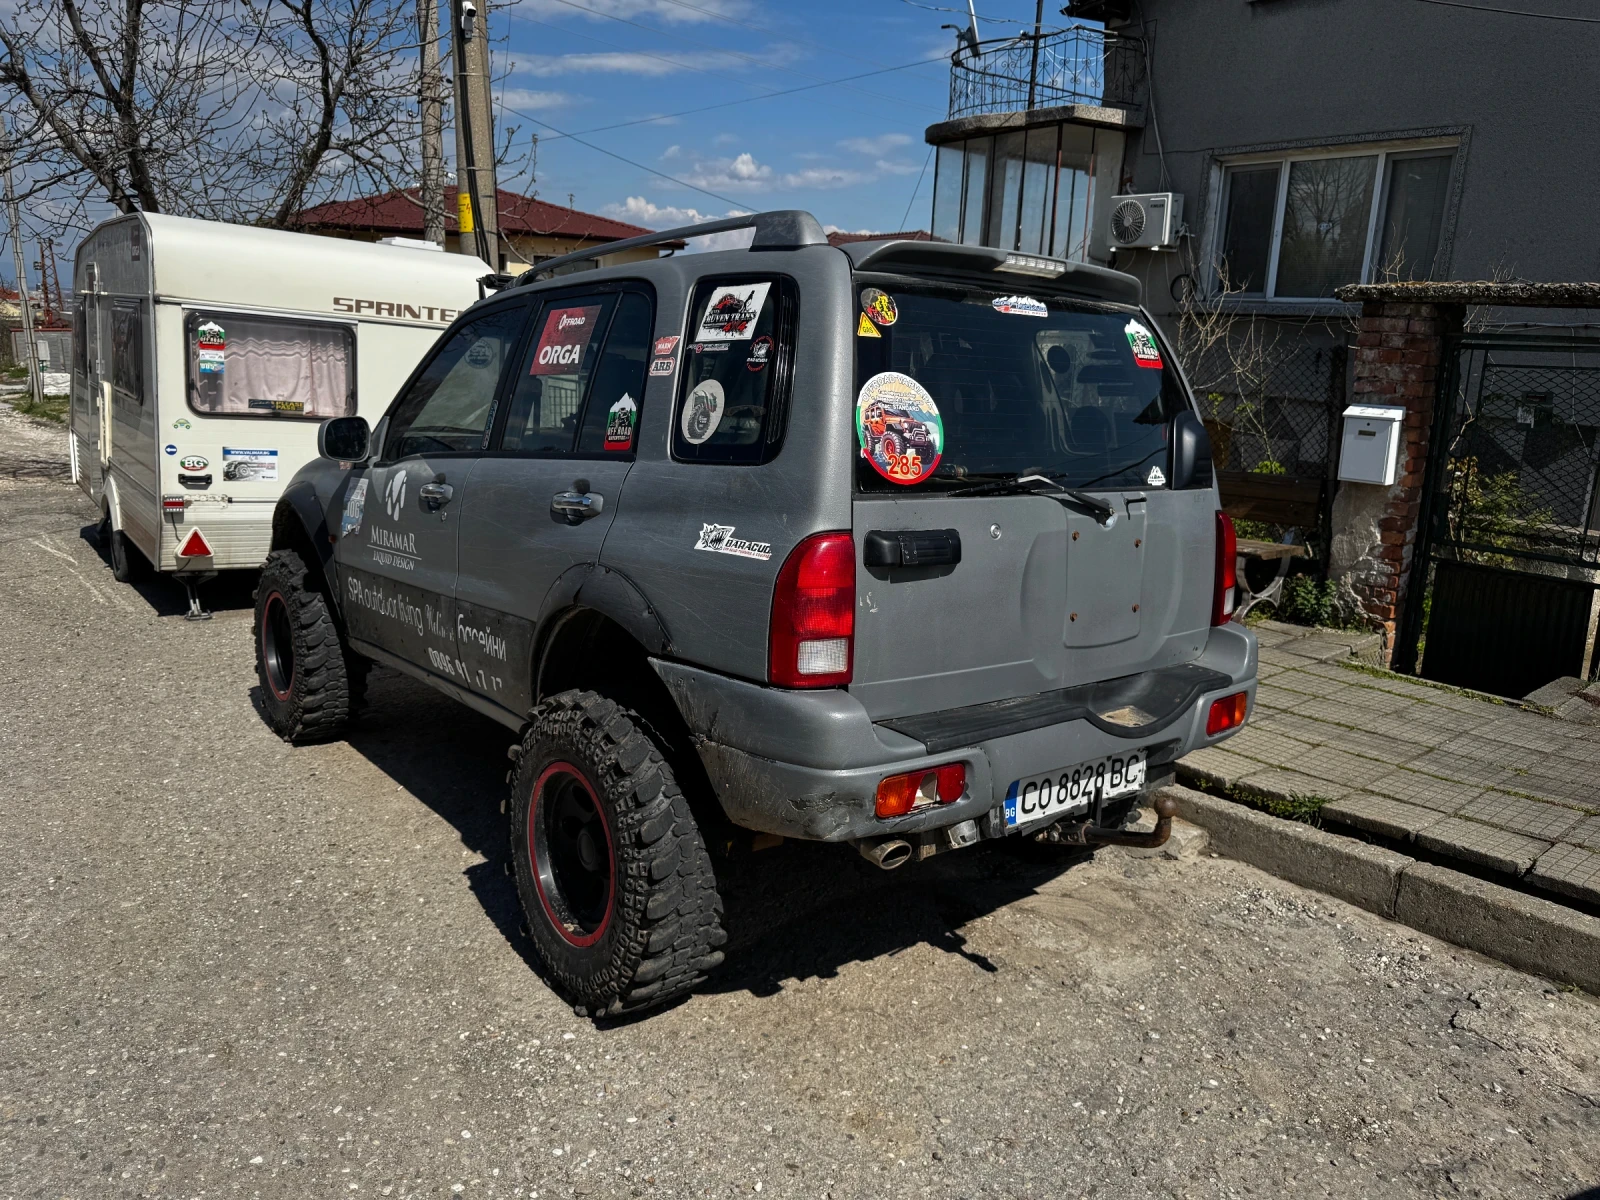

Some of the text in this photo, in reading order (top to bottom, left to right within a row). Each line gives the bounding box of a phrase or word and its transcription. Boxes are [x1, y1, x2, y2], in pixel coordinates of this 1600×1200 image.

[538, 344, 581, 365] ORGA
[653, 361, 672, 371] ARB
[184, 459, 204, 467] BG
[888, 454, 922, 477] 285
[371, 525, 417, 554] MIRAMAR
[392, 556, 415, 570] DESIGN
[348, 576, 365, 605] SPA
[428, 647, 456, 676] 0896
[454, 659, 471, 683] 91
[1021, 754, 1140, 814] CO 8828 BC
[1005, 807, 1016, 818] BG
